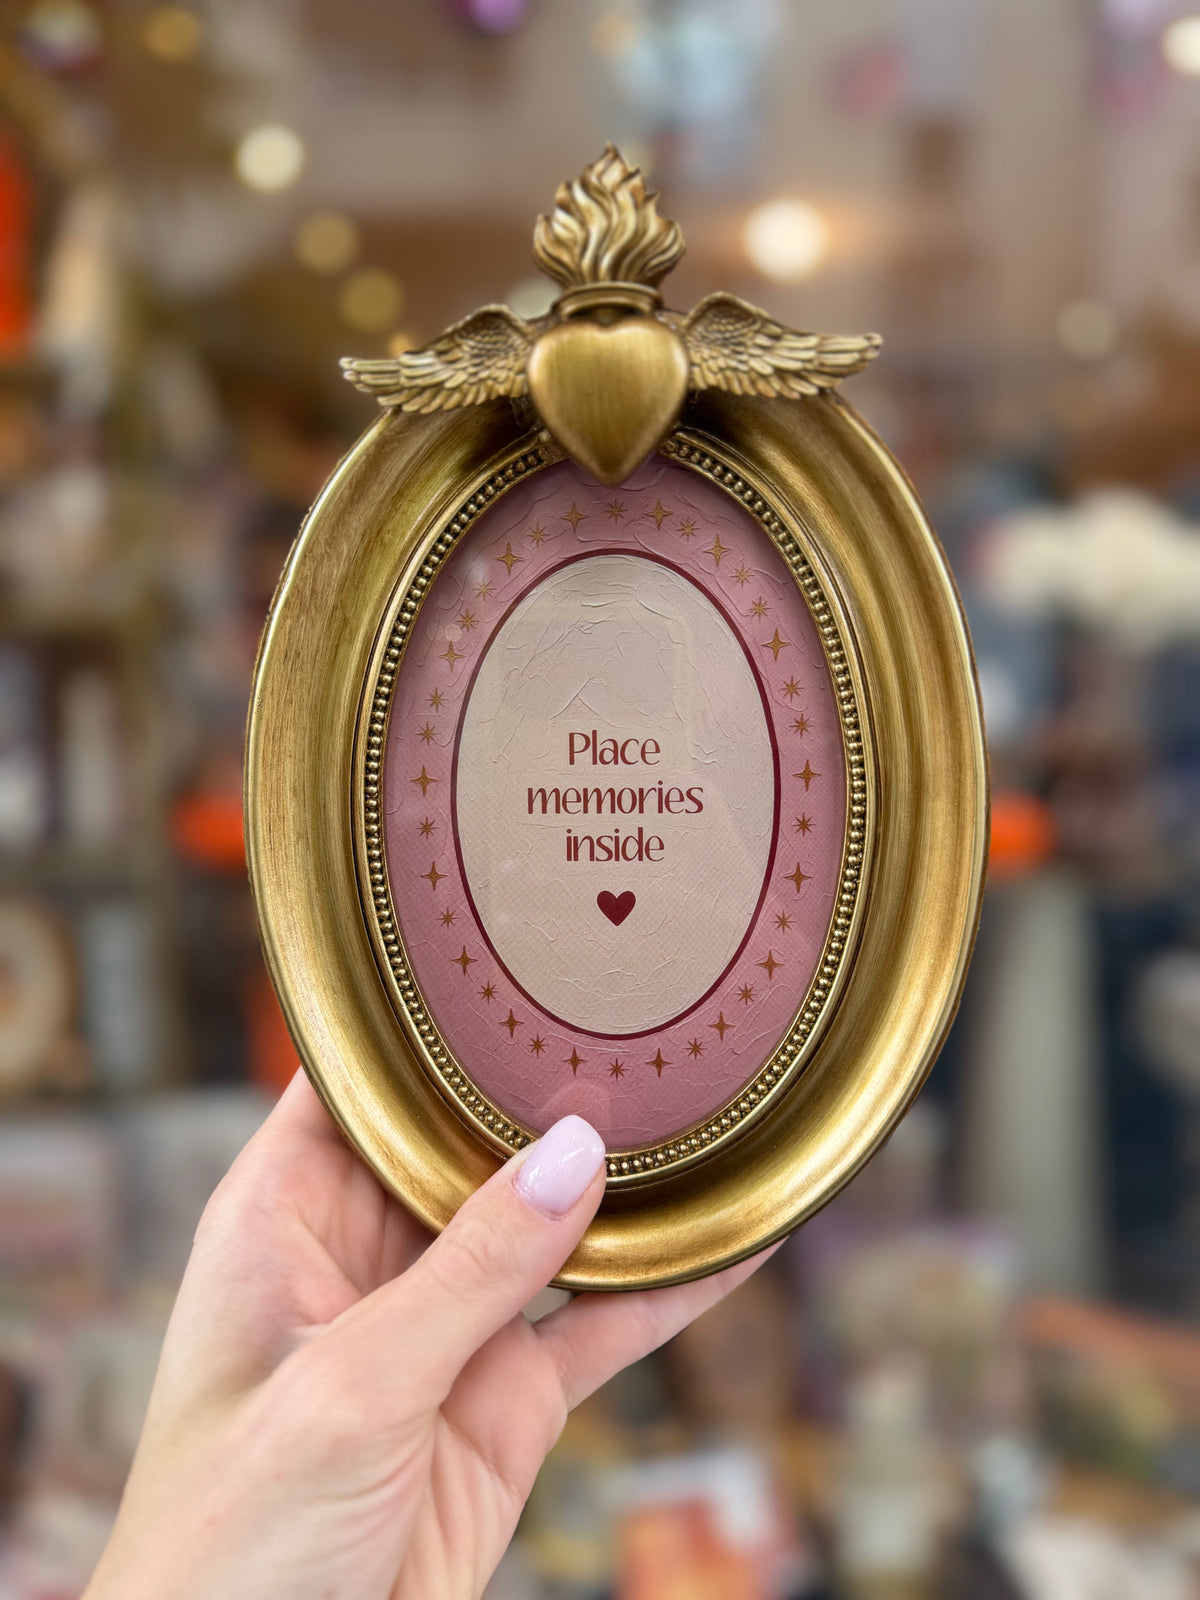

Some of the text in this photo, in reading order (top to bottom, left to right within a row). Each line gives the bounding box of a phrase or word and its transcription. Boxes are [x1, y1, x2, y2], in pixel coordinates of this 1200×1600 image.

[568, 729, 661, 765] Place
[527, 780, 704, 814] memories
[566, 827, 665, 862] inside
